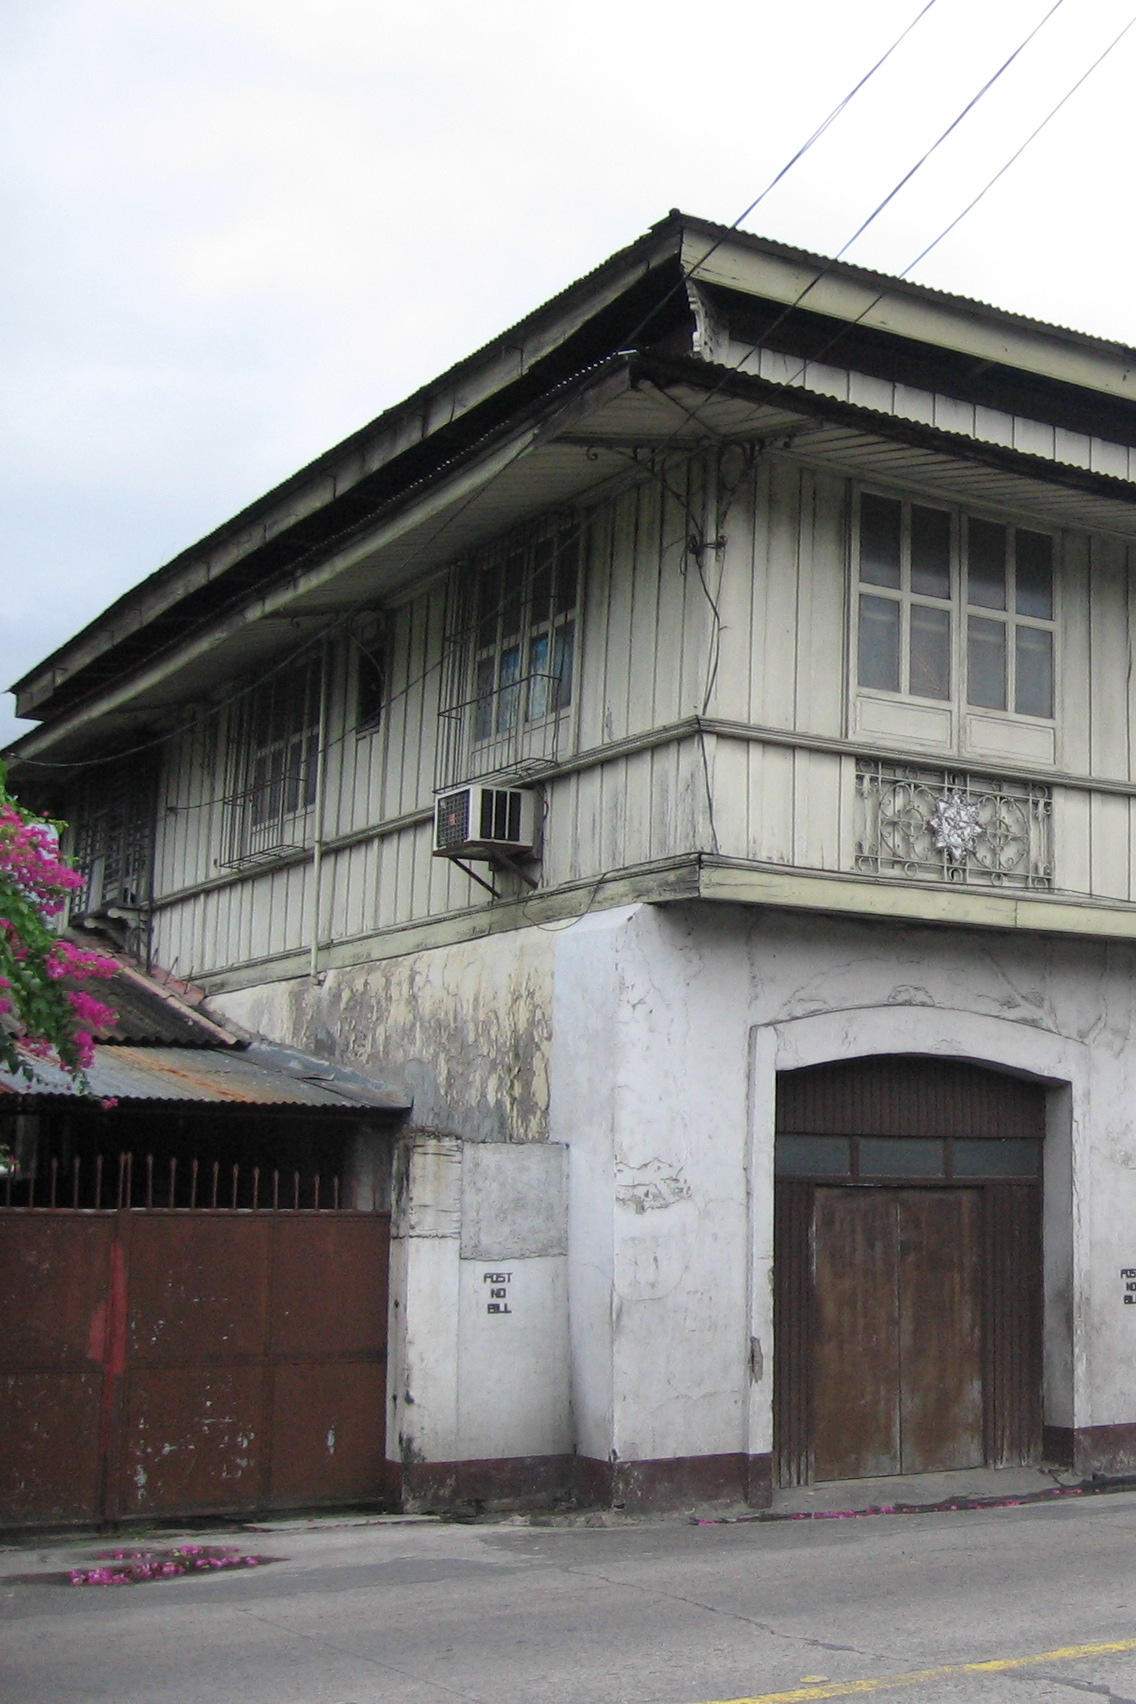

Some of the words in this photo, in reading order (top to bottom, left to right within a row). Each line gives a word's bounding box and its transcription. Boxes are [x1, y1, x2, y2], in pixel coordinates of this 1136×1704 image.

[483, 1272, 513, 1283] POST
[491, 1287, 506, 1298] NO
[487, 1303, 512, 1314] BILL
